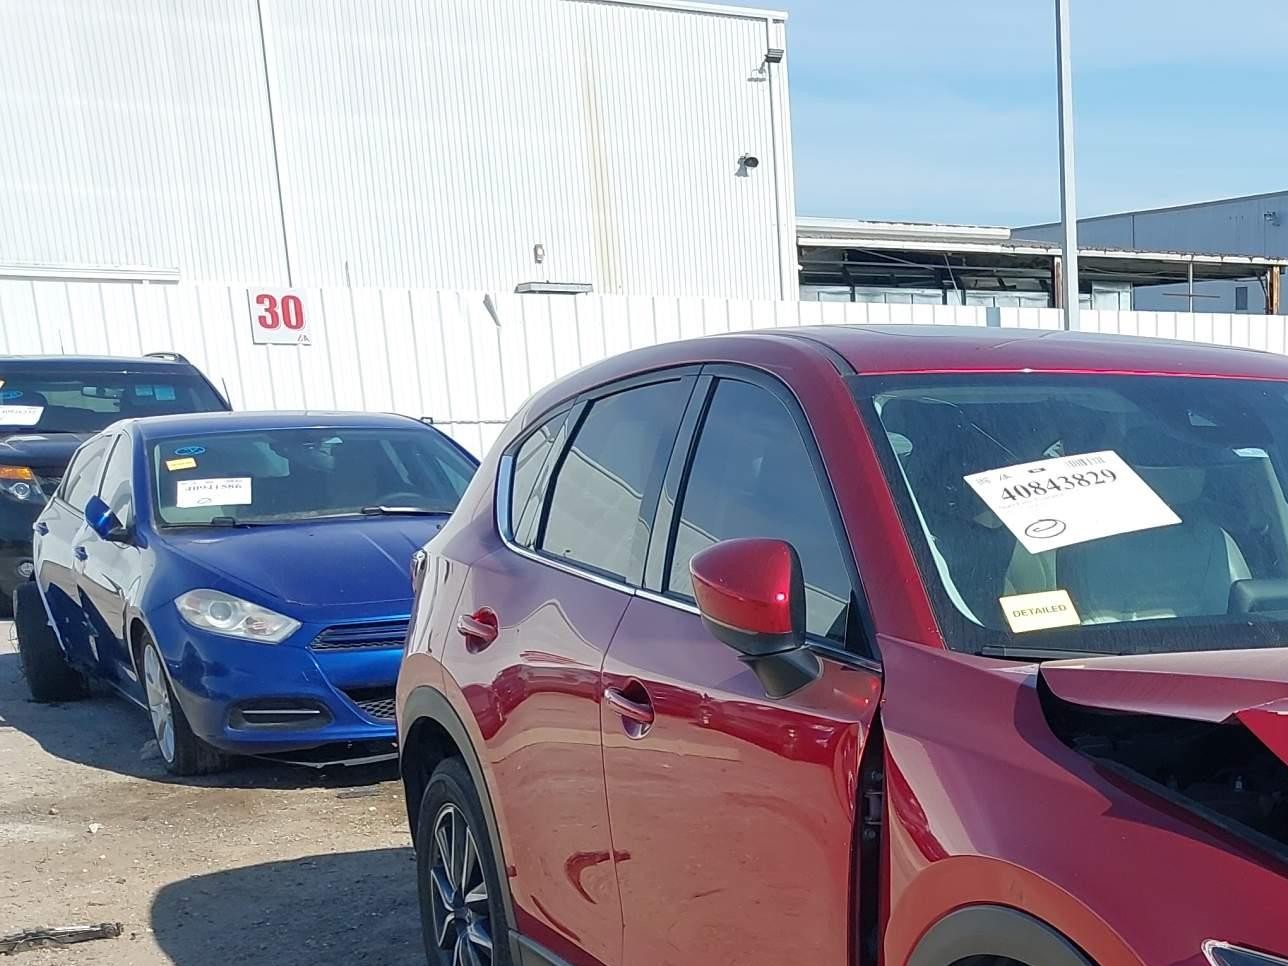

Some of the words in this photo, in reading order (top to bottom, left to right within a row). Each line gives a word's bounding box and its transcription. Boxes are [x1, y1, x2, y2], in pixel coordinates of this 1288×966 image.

[256, 294, 305, 330] 30
[1001, 469, 1117, 501] 40843829
[1012, 604, 1068, 618] DETAILED
